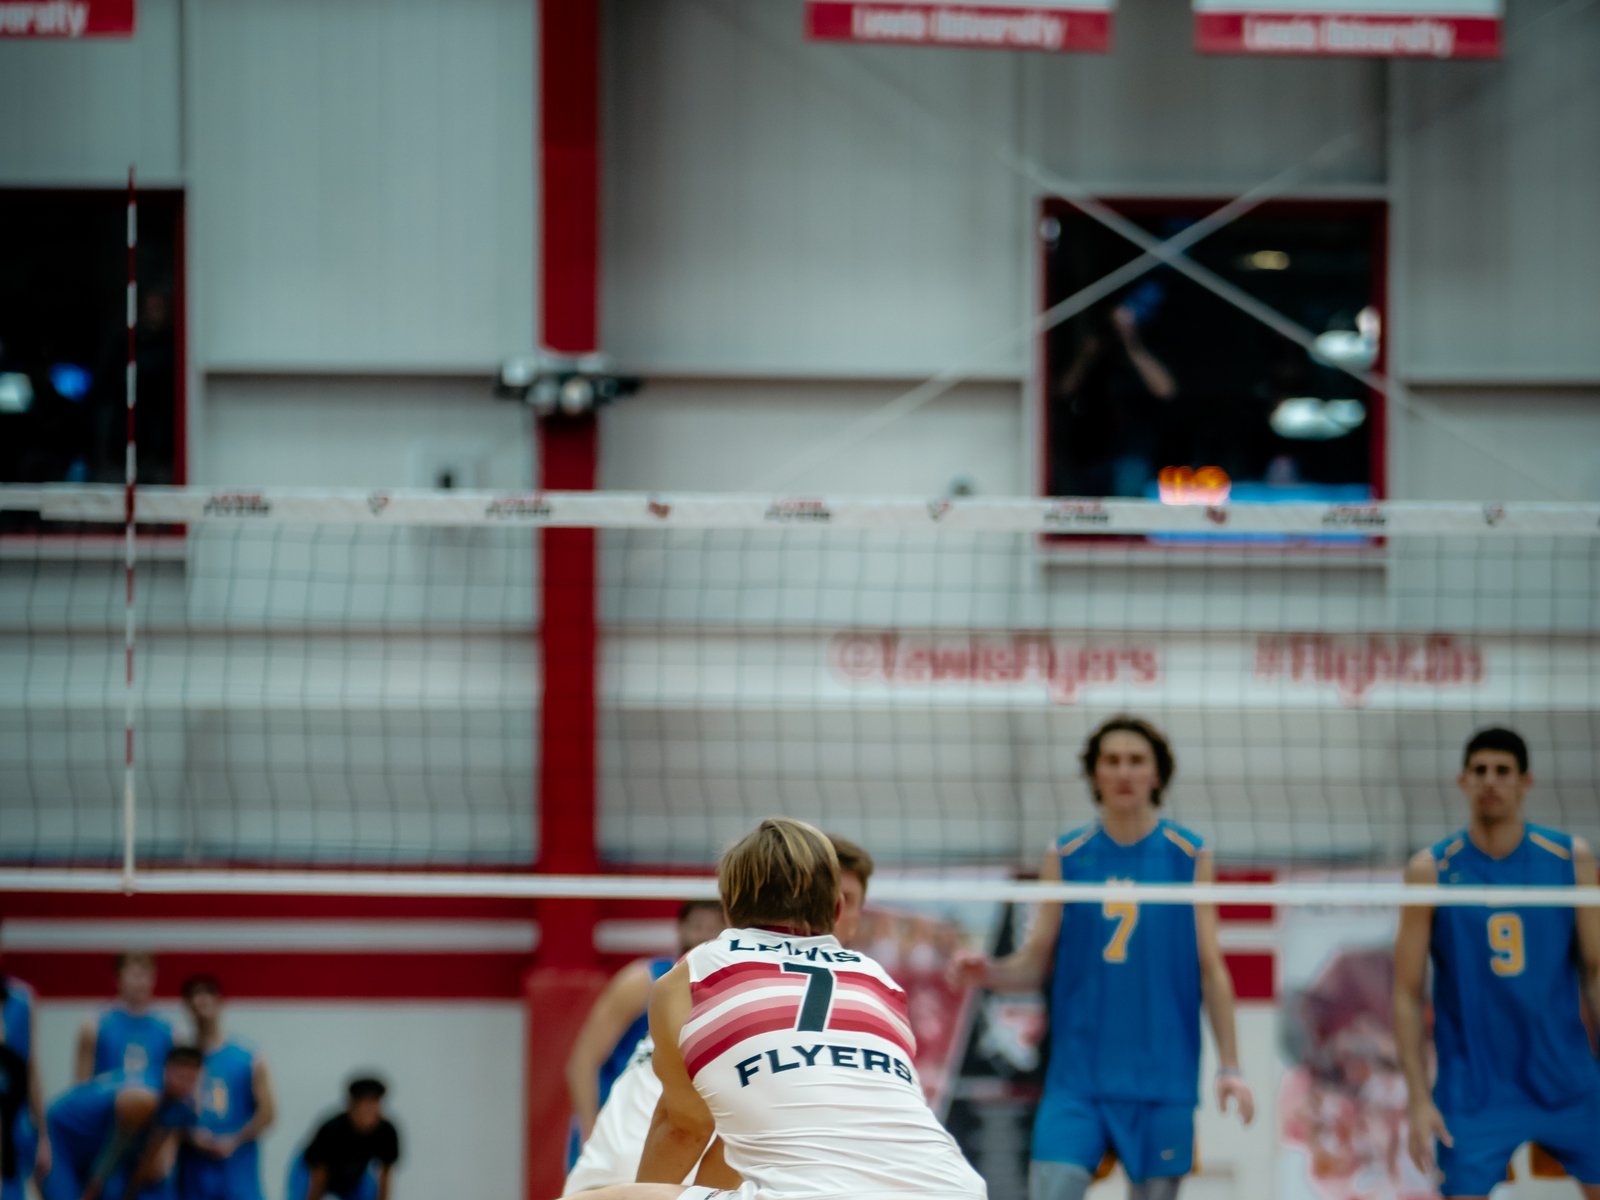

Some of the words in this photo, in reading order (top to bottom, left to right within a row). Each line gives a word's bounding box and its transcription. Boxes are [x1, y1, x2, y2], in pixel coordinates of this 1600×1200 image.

[729, 938, 862, 963] LEWIS
[1102, 897, 1140, 963] 7
[1487, 911, 1526, 977] 9
[780, 961, 837, 1033] 7
[734, 1043, 913, 1088] FLYERS
